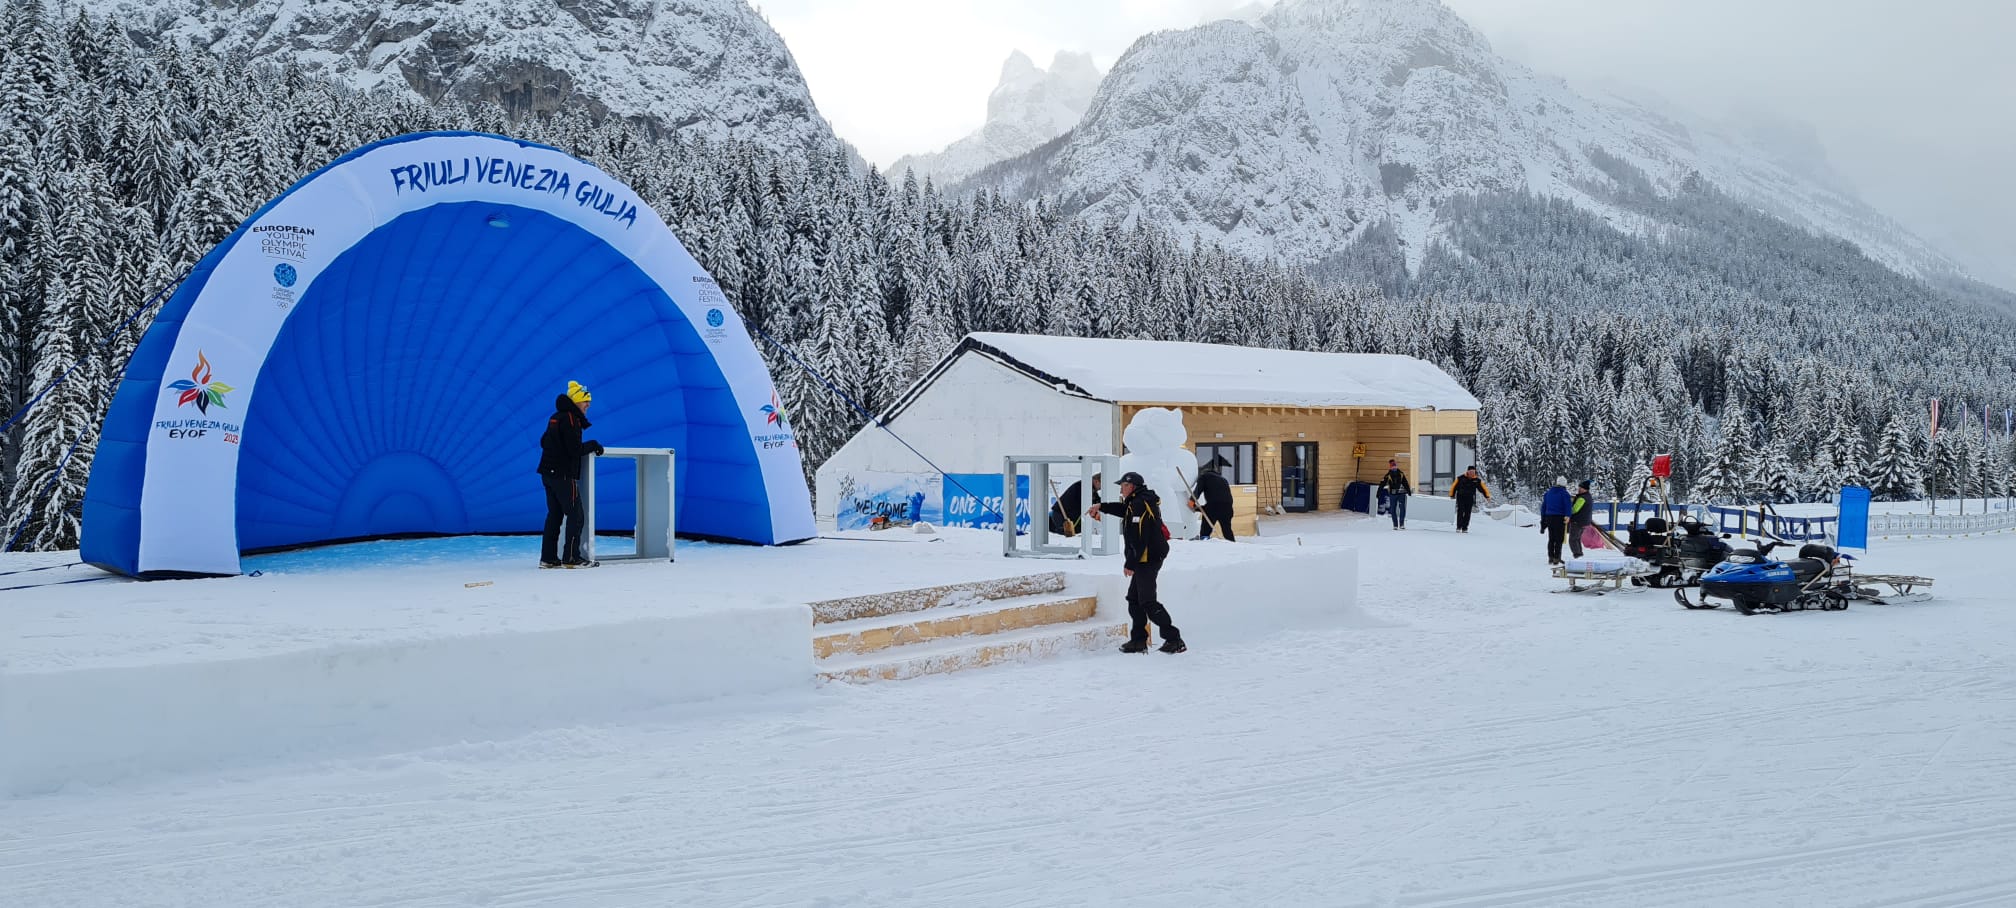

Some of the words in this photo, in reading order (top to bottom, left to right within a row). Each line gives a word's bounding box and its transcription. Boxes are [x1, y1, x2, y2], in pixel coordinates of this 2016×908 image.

[390, 158, 470, 195] FRIULI
[476, 156, 570, 200] VENEZIA
[575, 180, 637, 230] GIULIA
[253, 225, 314, 236] EUROPEAN
[266, 232, 304, 242] YOUTH
[261, 239, 309, 251] OLYMPIC
[262, 246, 307, 259] FESTIVAL
[156, 421, 182, 430] FRIULI
[185, 420, 220, 429] VENEZIA
[169, 428, 207, 439] EYOF
[763, 441, 785, 449] EYOF
[854, 497, 908, 519] WELCOME
[949, 493, 978, 516] ONE
